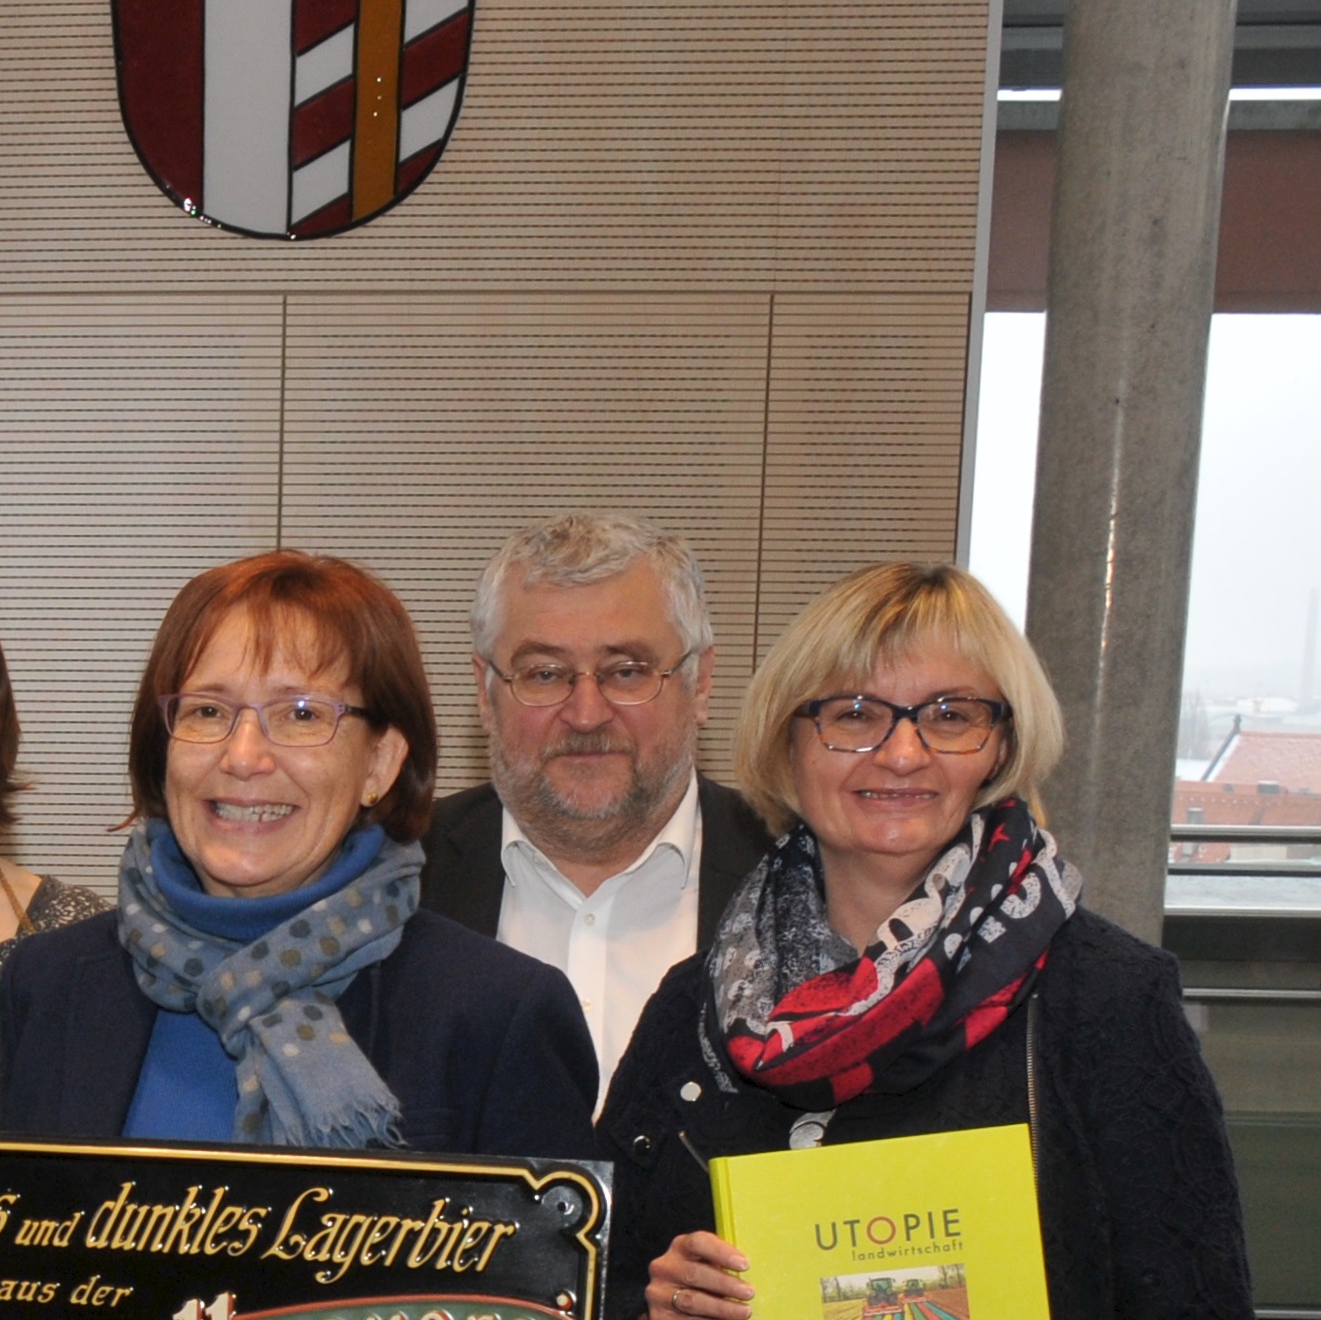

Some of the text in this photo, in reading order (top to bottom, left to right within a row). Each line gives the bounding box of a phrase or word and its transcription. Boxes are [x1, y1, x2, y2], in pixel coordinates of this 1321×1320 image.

[14, 1210, 85, 1248] und
[85, 1181, 272, 1257] dunkles
[261, 1187, 519, 1284] Lagerbier
[814, 1208, 962, 1251] UTOPIE
[852, 1239, 964, 1261] landwirtschaft
[69, 1274, 134, 1308] der
